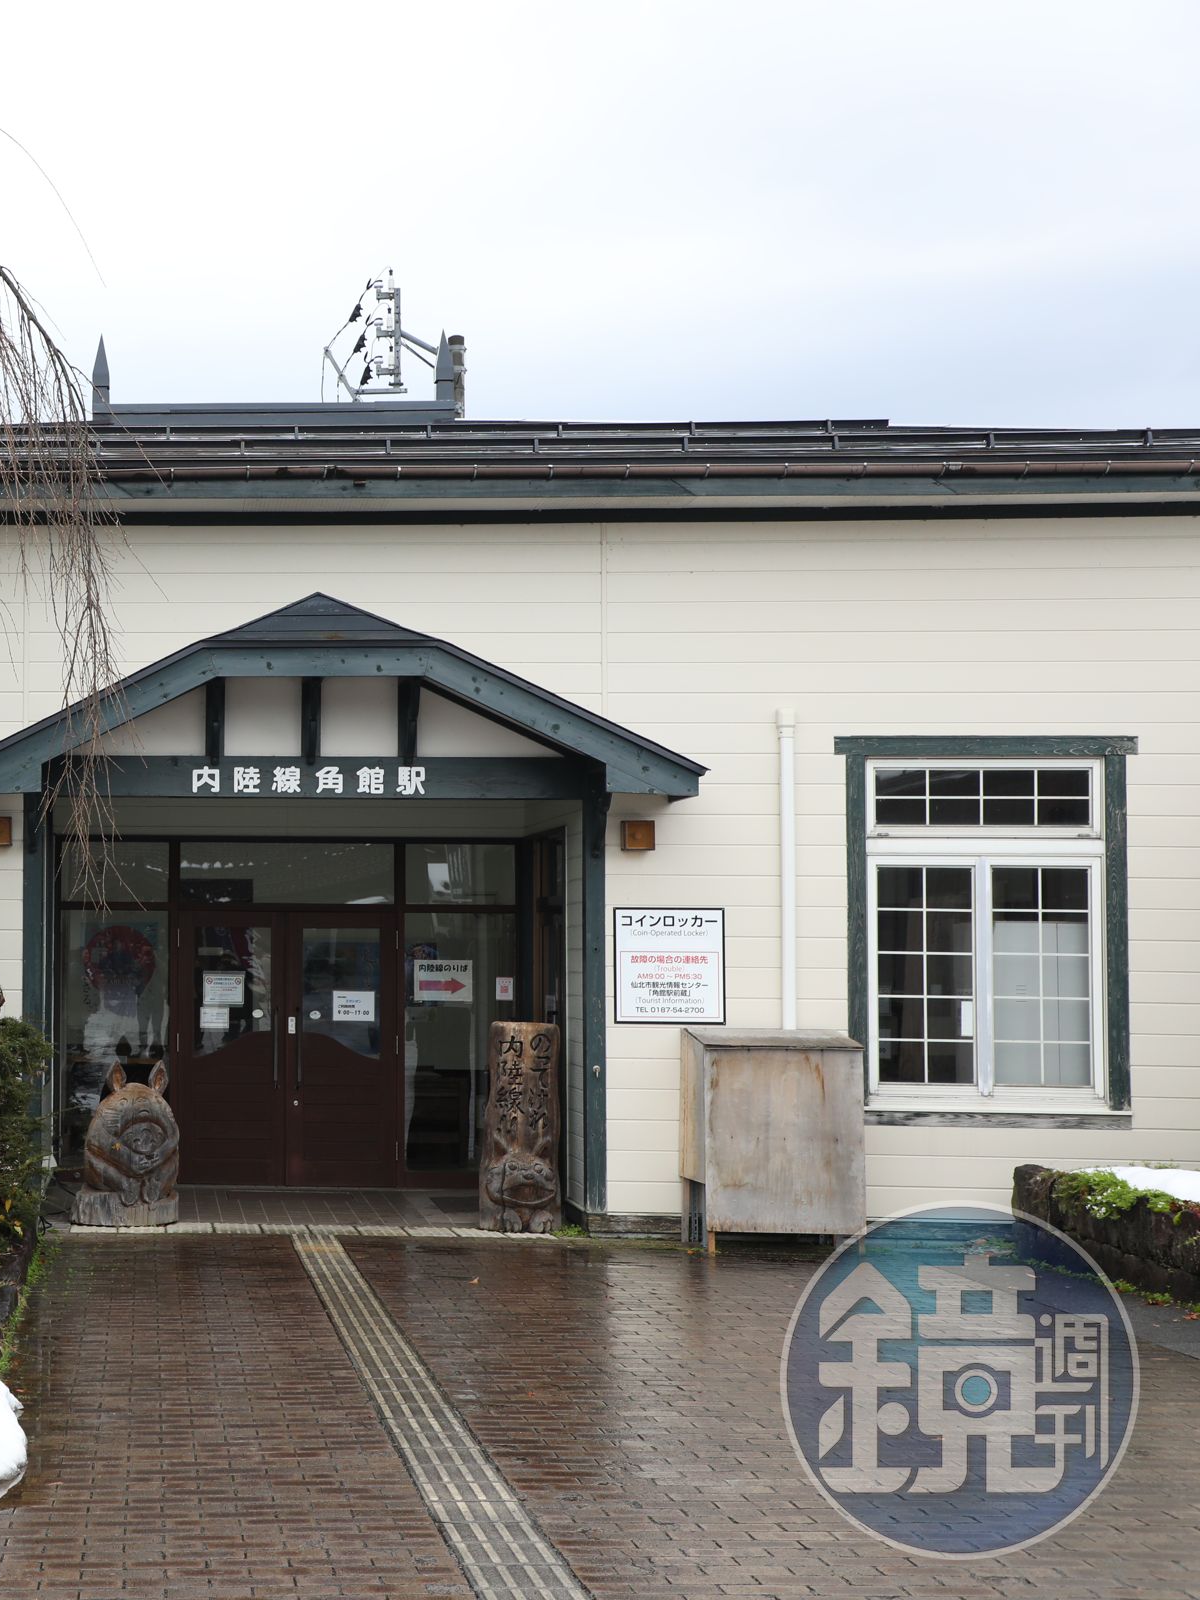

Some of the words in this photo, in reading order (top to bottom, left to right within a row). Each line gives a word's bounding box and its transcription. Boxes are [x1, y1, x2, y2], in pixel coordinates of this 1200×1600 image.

[192, 766, 426, 795] 内陸線角館駅
[621, 915, 718, 928] コインロッカー
[630, 955, 709, 965] 故障の場合の連絡先
[418, 964, 468, 973] 内陸線のりば
